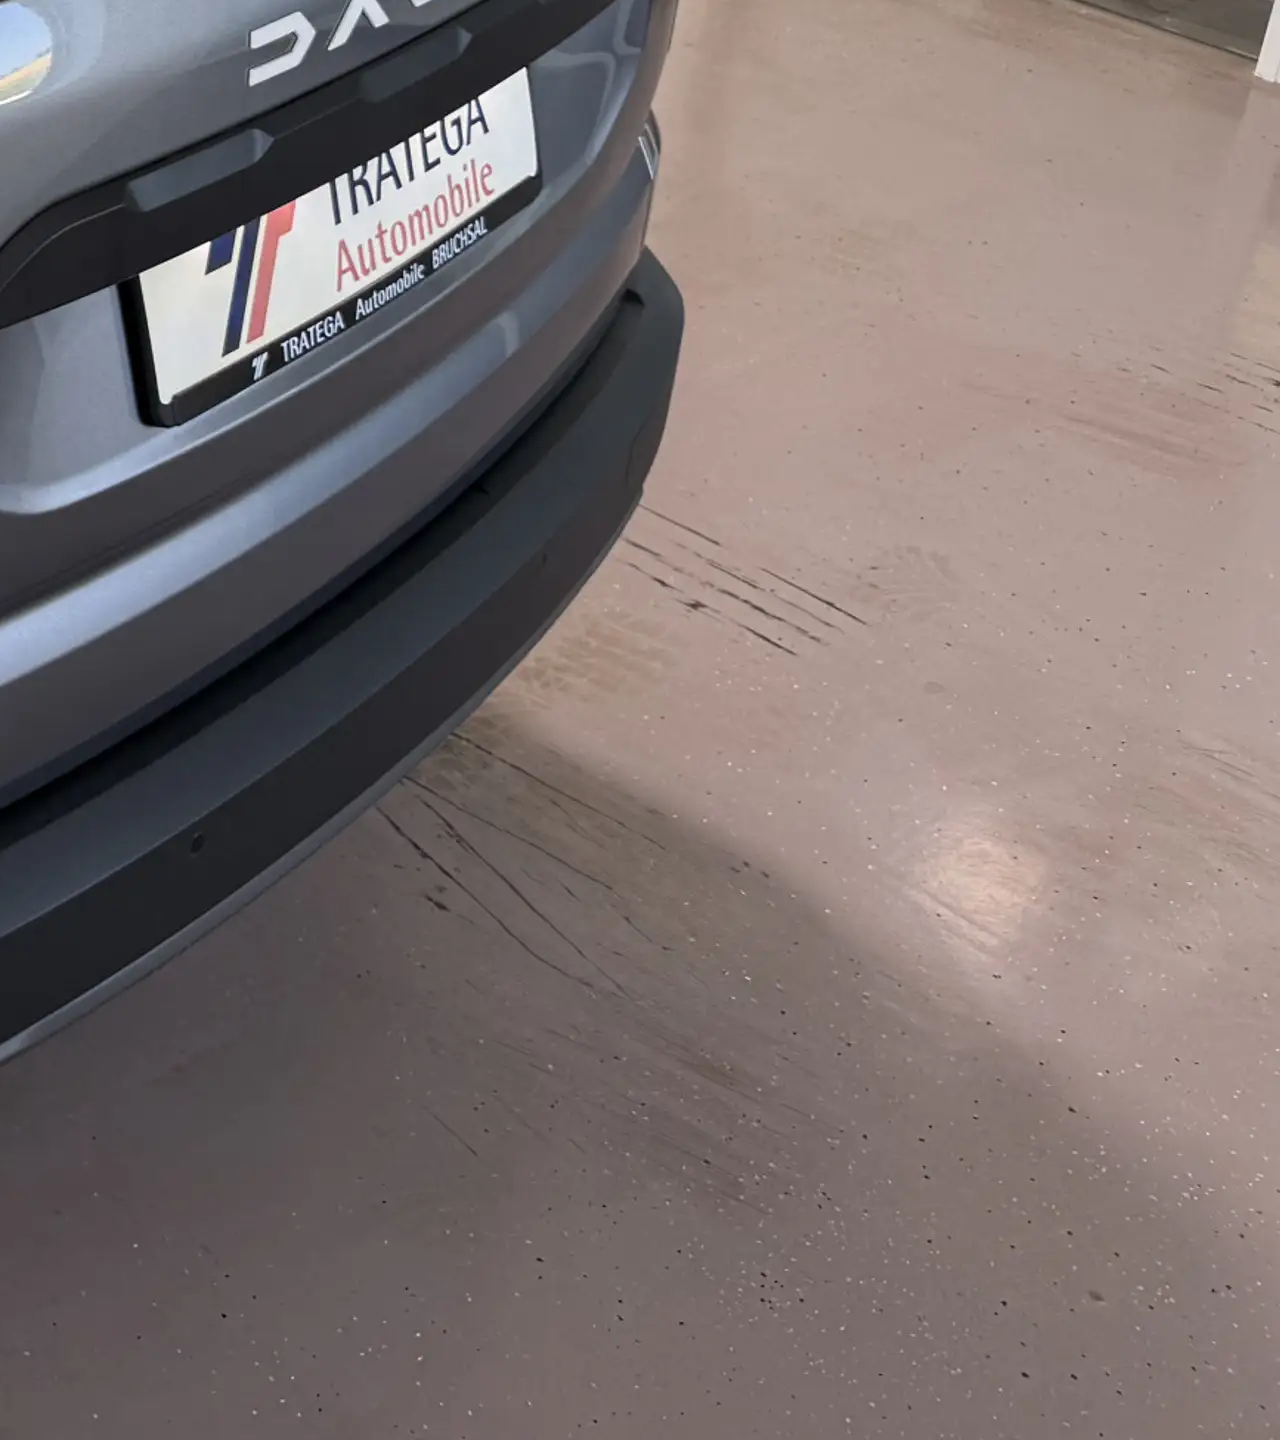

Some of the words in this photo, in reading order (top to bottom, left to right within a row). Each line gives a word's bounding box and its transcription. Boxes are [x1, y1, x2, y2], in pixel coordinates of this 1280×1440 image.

[281, 310, 346, 362] TRATEGA
[355, 262, 425, 320] Automobile
[431, 215, 488, 270] BRUCHSAL
[335, 157, 496, 292] Automobile
